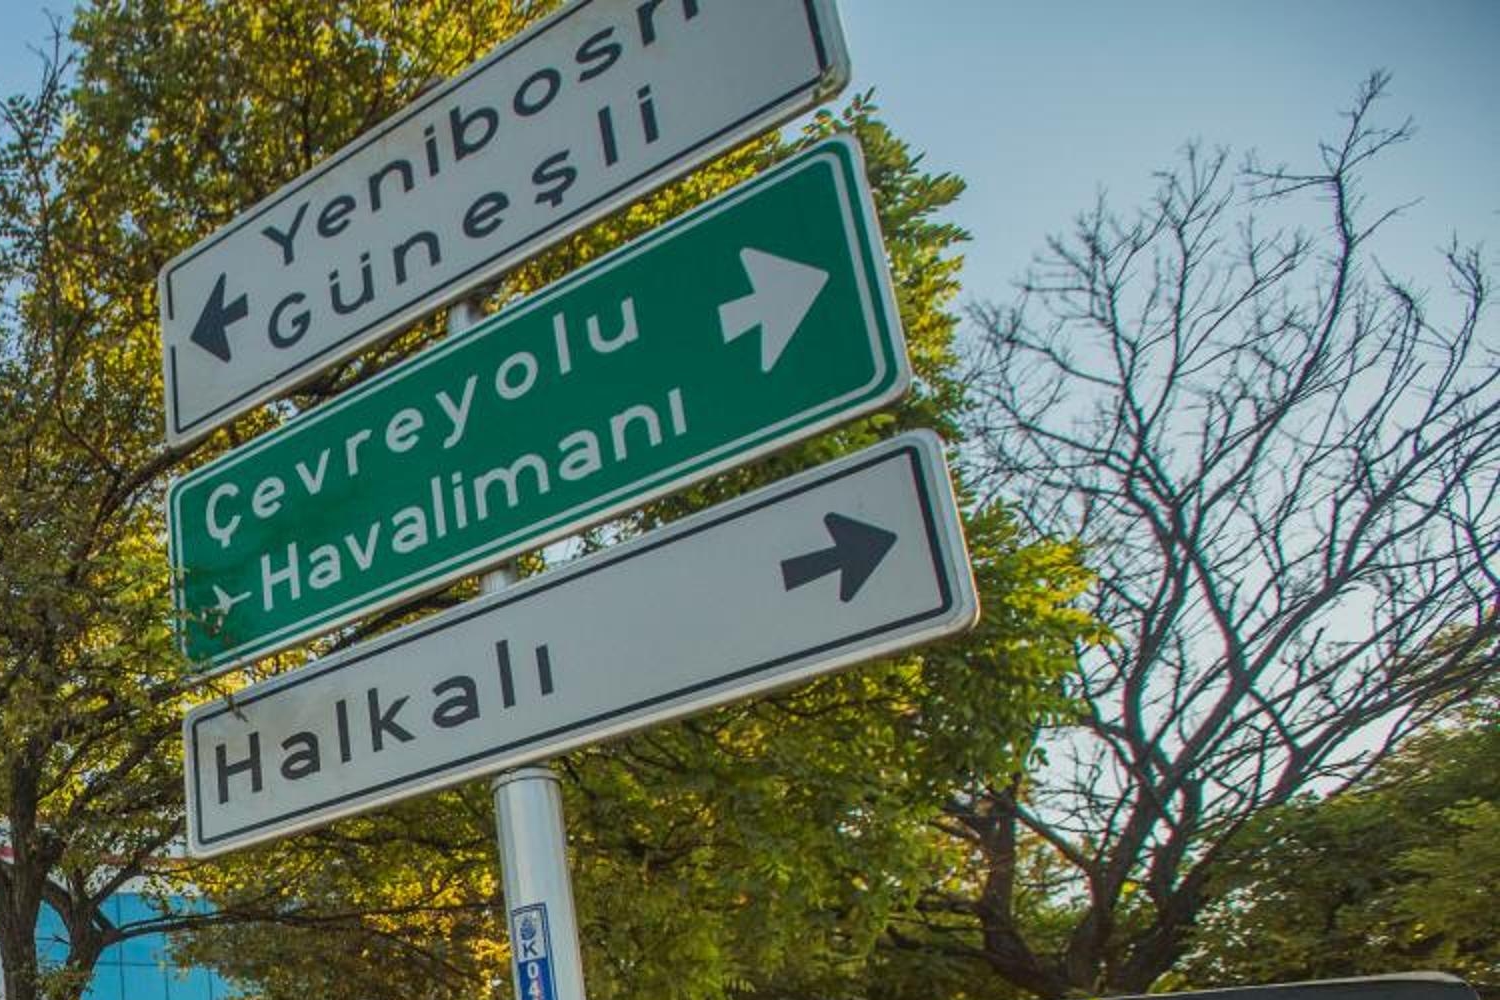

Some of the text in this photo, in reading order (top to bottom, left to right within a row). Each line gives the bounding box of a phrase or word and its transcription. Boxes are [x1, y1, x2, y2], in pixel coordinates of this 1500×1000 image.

[267, 84, 660, 350] Güneşli
[206, 298, 638, 547] Çevreyolu
[261, 389, 686, 611] Havalimanı
[215, 639, 554, 804] Halkalı
